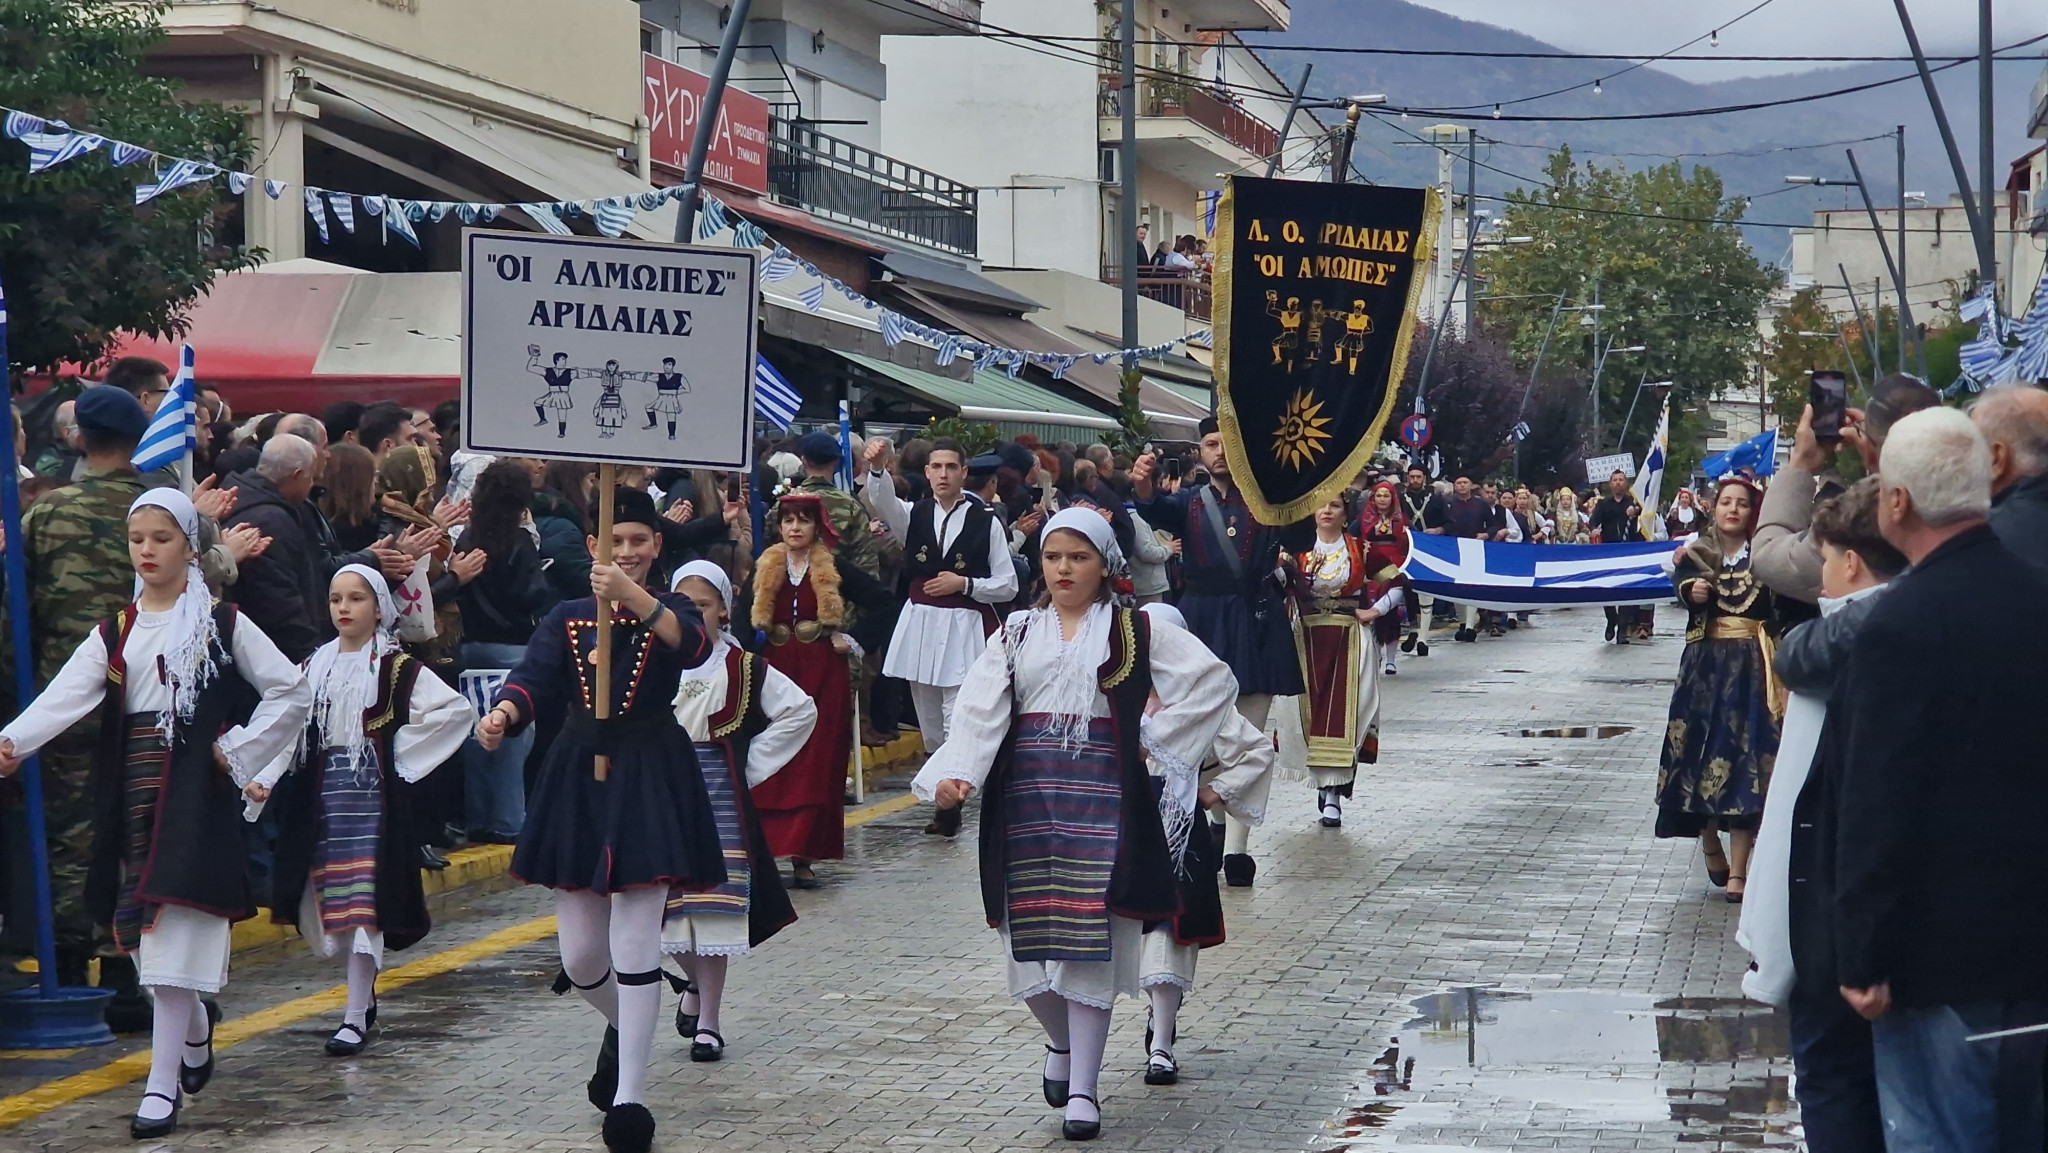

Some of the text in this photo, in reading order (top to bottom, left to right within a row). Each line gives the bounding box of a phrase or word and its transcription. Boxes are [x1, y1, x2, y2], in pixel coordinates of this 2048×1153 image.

[646, 64, 733, 156] ΣΥΡΙΑ
[701, 159, 734, 182] ΜΩΠΙΑΣ
[1282, 220, 1305, 244] Ο.
[487, 254, 736, 296] "ΟΙ ΑΛΜΩΠΕΣ"
[528, 300, 693, 337] ΑΡΙΔΑΙΑΣ
